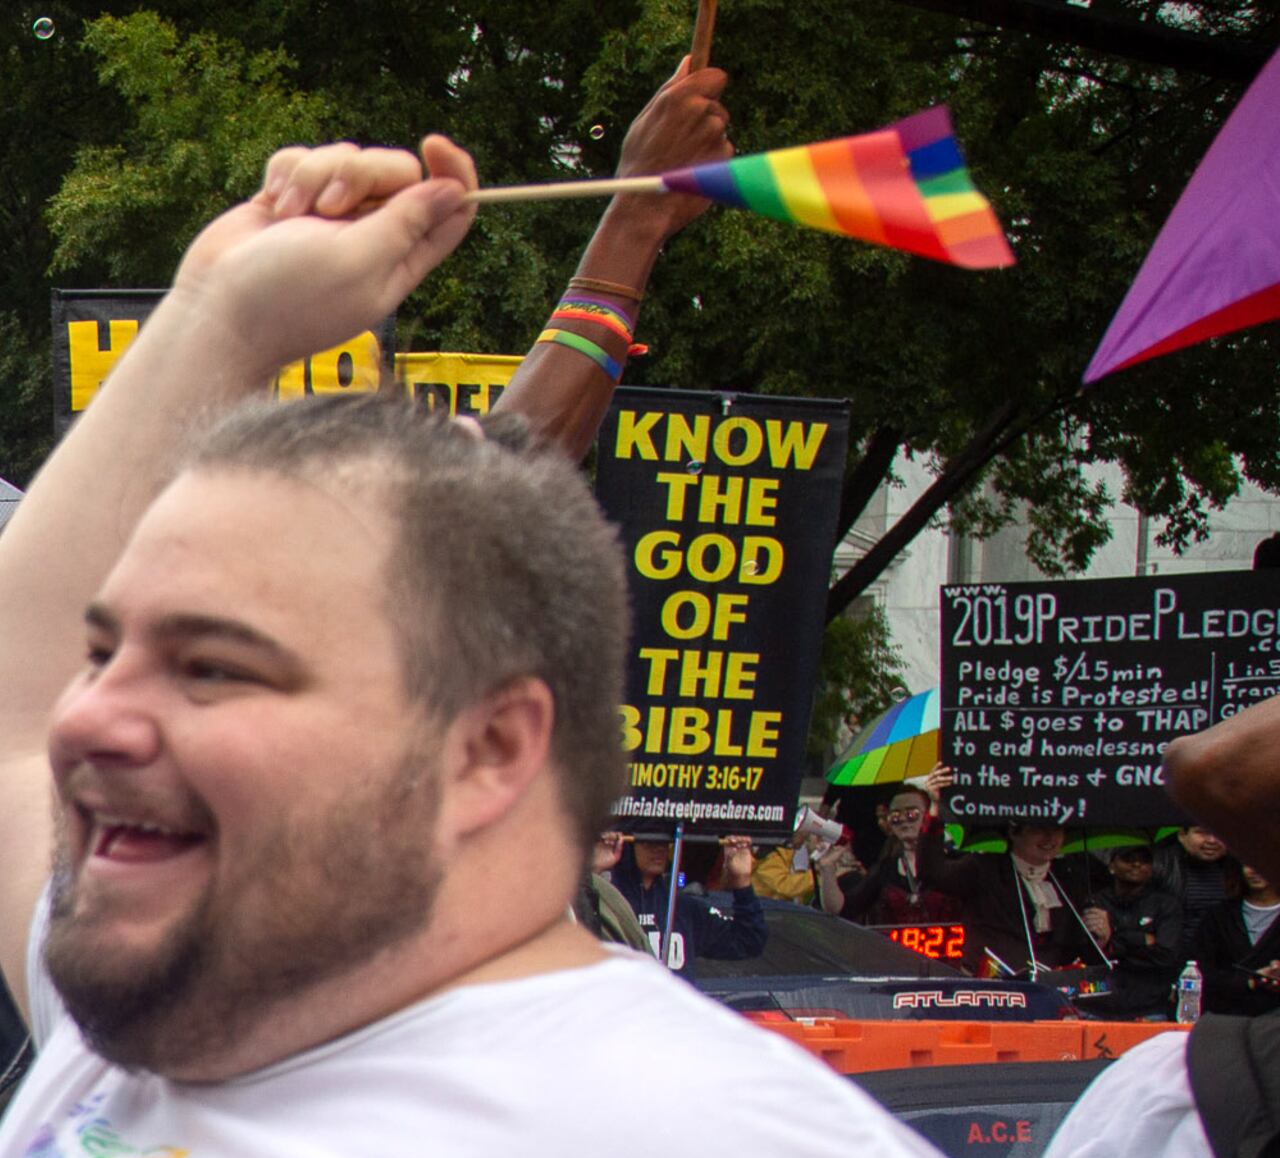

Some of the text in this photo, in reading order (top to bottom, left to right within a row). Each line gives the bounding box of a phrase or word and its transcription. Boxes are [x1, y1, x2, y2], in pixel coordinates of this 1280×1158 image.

[615, 409, 828, 471] KNOW
[655, 471, 781, 528] THE
[634, 530, 785, 586] GOD
[944, 585, 1008, 598] www.
[660, 590, 749, 641] OF
[952, 588, 1280, 647] 2019PRIDEPLEDG
[639, 647, 760, 700] THE
[958, 659, 1040, 690] Pledge
[1246, 664, 1266, 677] in
[958, 680, 1208, 706] Pride is Protested!
[616, 704, 783, 758] BIBLE
[953, 709, 1208, 739] ALL $ goes to THAP
[952, 736, 976, 756] to
[990, 738, 1033, 757] end
[704, 765, 764, 791] 3:16-17
[953, 767, 972, 786] in
[977, 763, 1012, 788] the
[1019, 766, 1080, 788] Trans
[949, 794, 1088, 825] Community!
[893, 990, 1026, 1009] ATLANTA
[967, 1120, 1033, 1144] A.C.E
